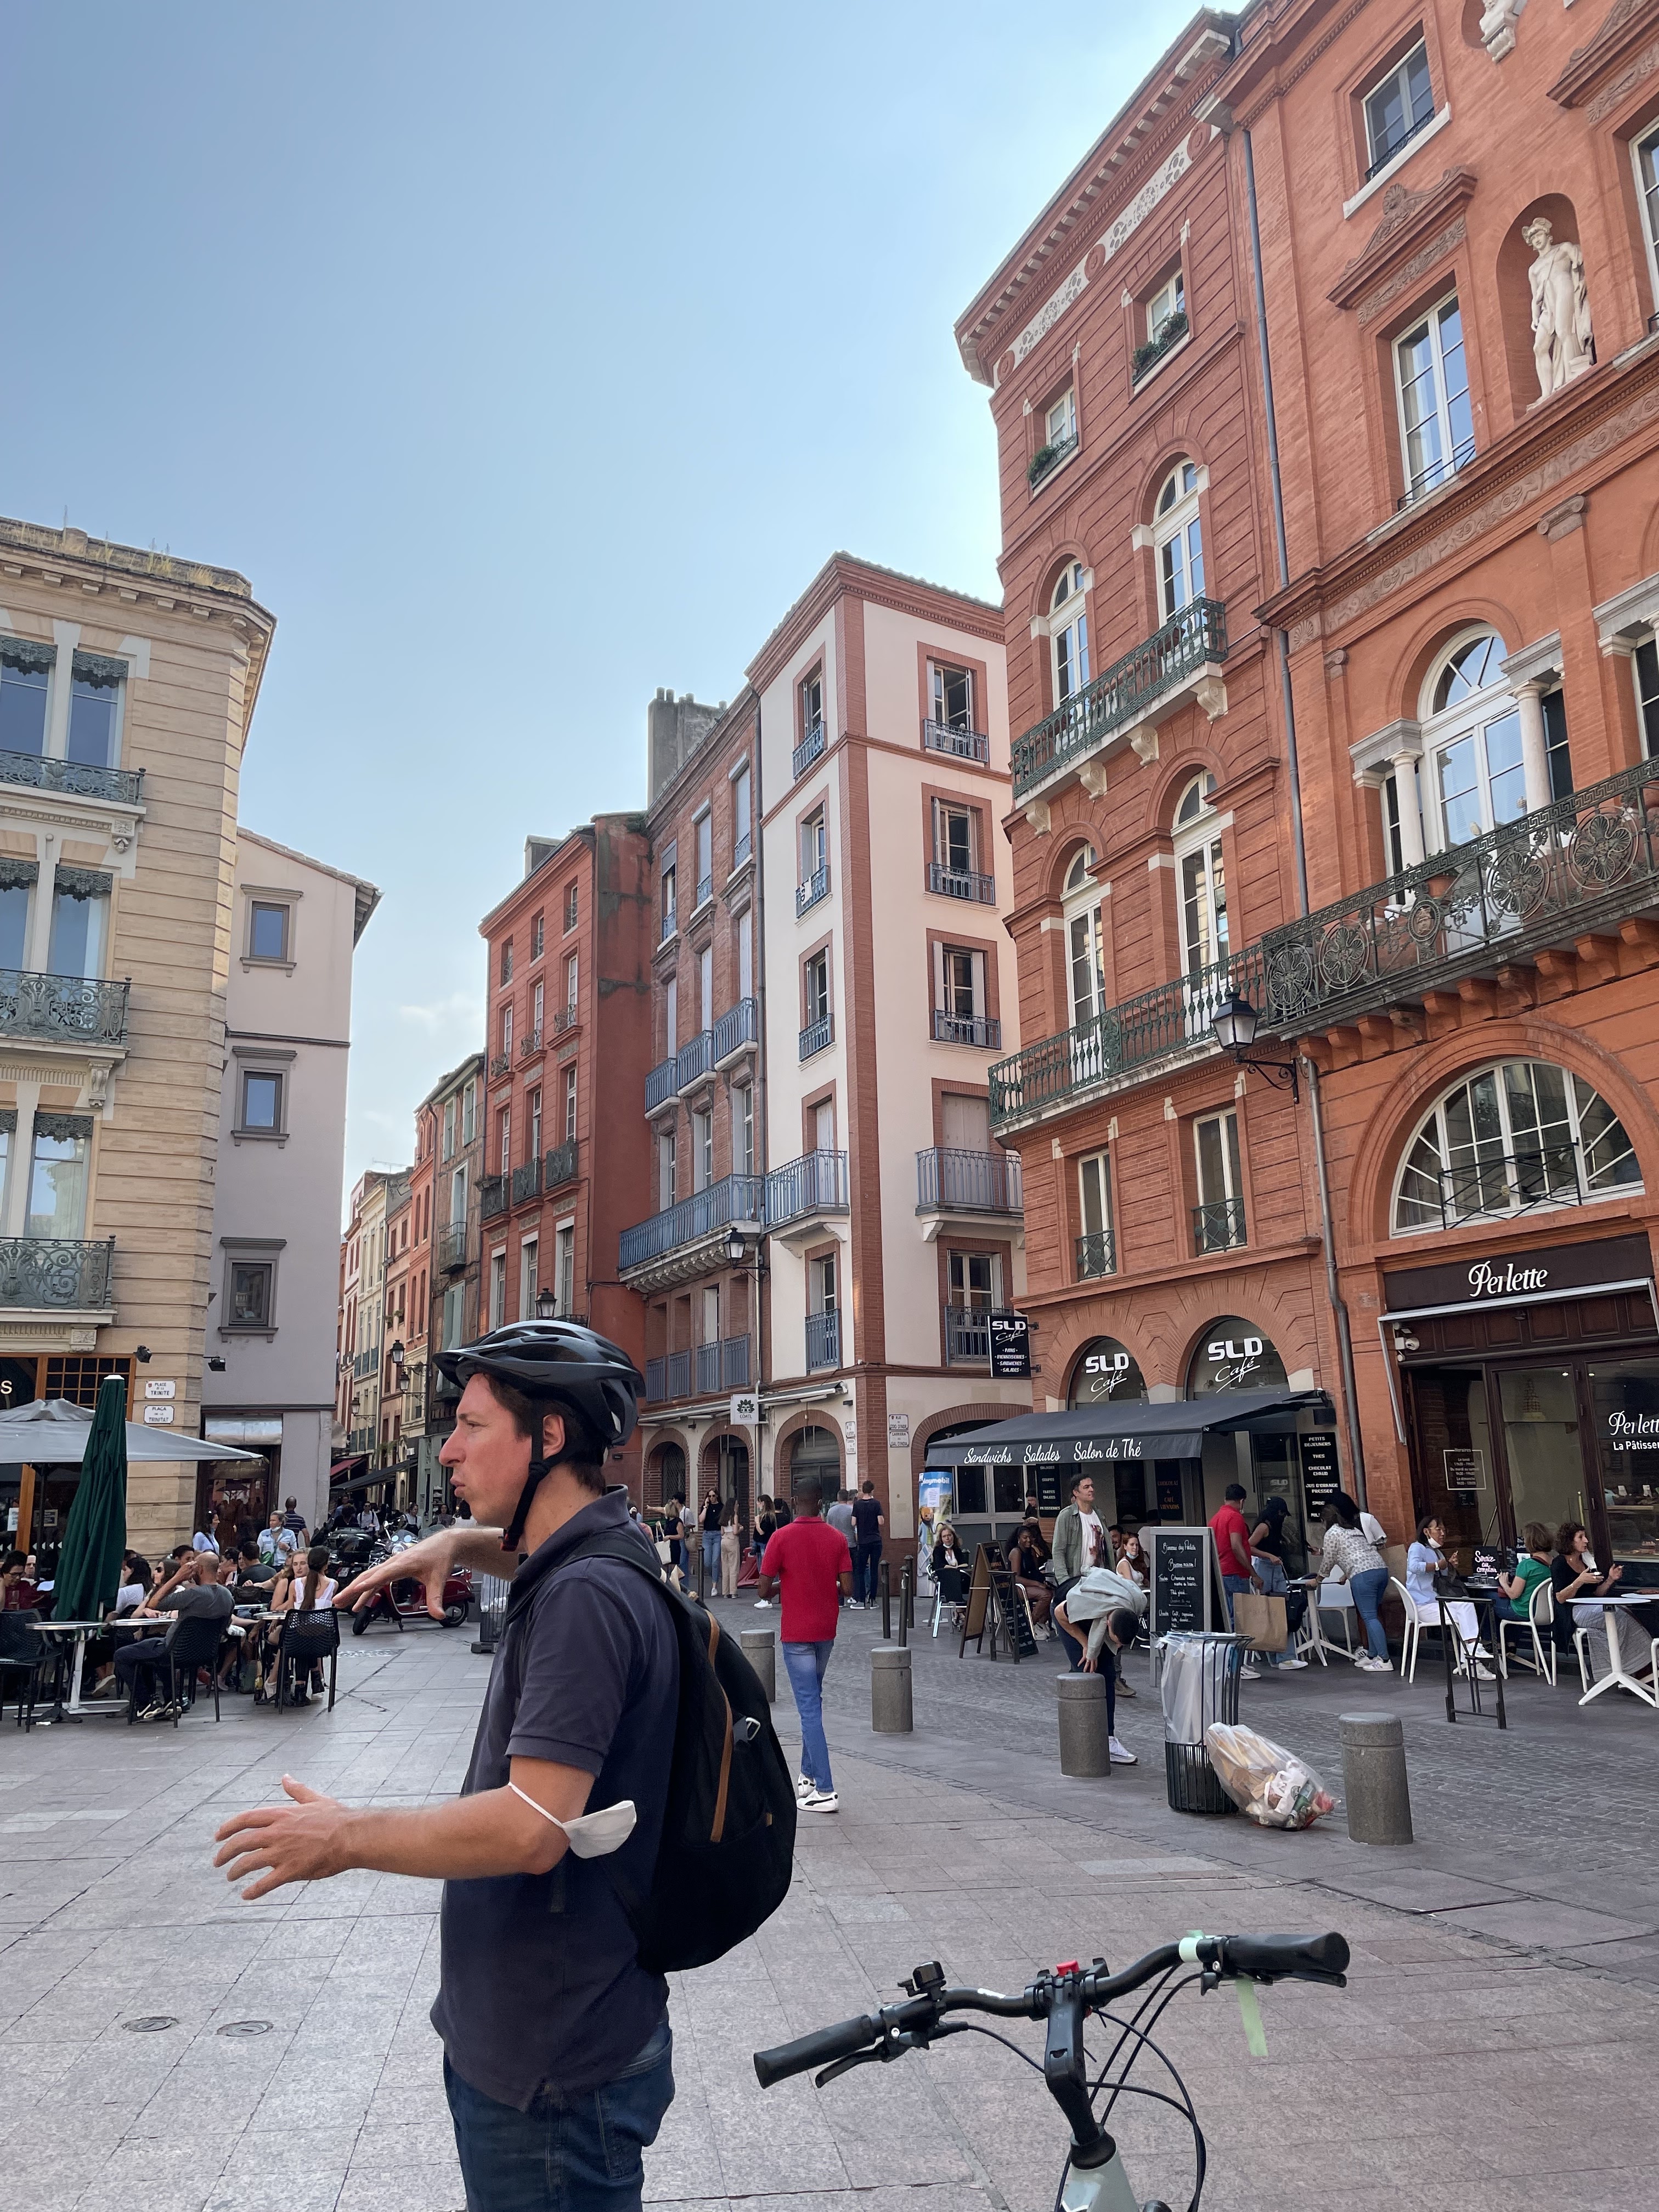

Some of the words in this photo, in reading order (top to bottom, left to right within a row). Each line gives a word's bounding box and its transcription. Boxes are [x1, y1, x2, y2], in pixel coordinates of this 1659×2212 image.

[1468, 1261, 1548, 1297] Perlette
[992, 1321, 1026, 1330] SLD
[996, 1330, 1024, 1346] Café
[1208, 1337, 1263, 1361] SLD
[1085, 1352, 1129, 1374] SLD
[1215, 1356, 1261, 1393] Café
[1091, 1370, 1127, 1402] Café
[964, 1447, 1012, 1464] Sandwichs
[1024, 1443, 1061, 1463] Salades
[1074, 1441, 1104, 1461] Salon
[1105, 1439, 1119, 1458] de
[1122, 1438, 1142, 1459] Thé
[1613, 1441, 1624, 1451] La
